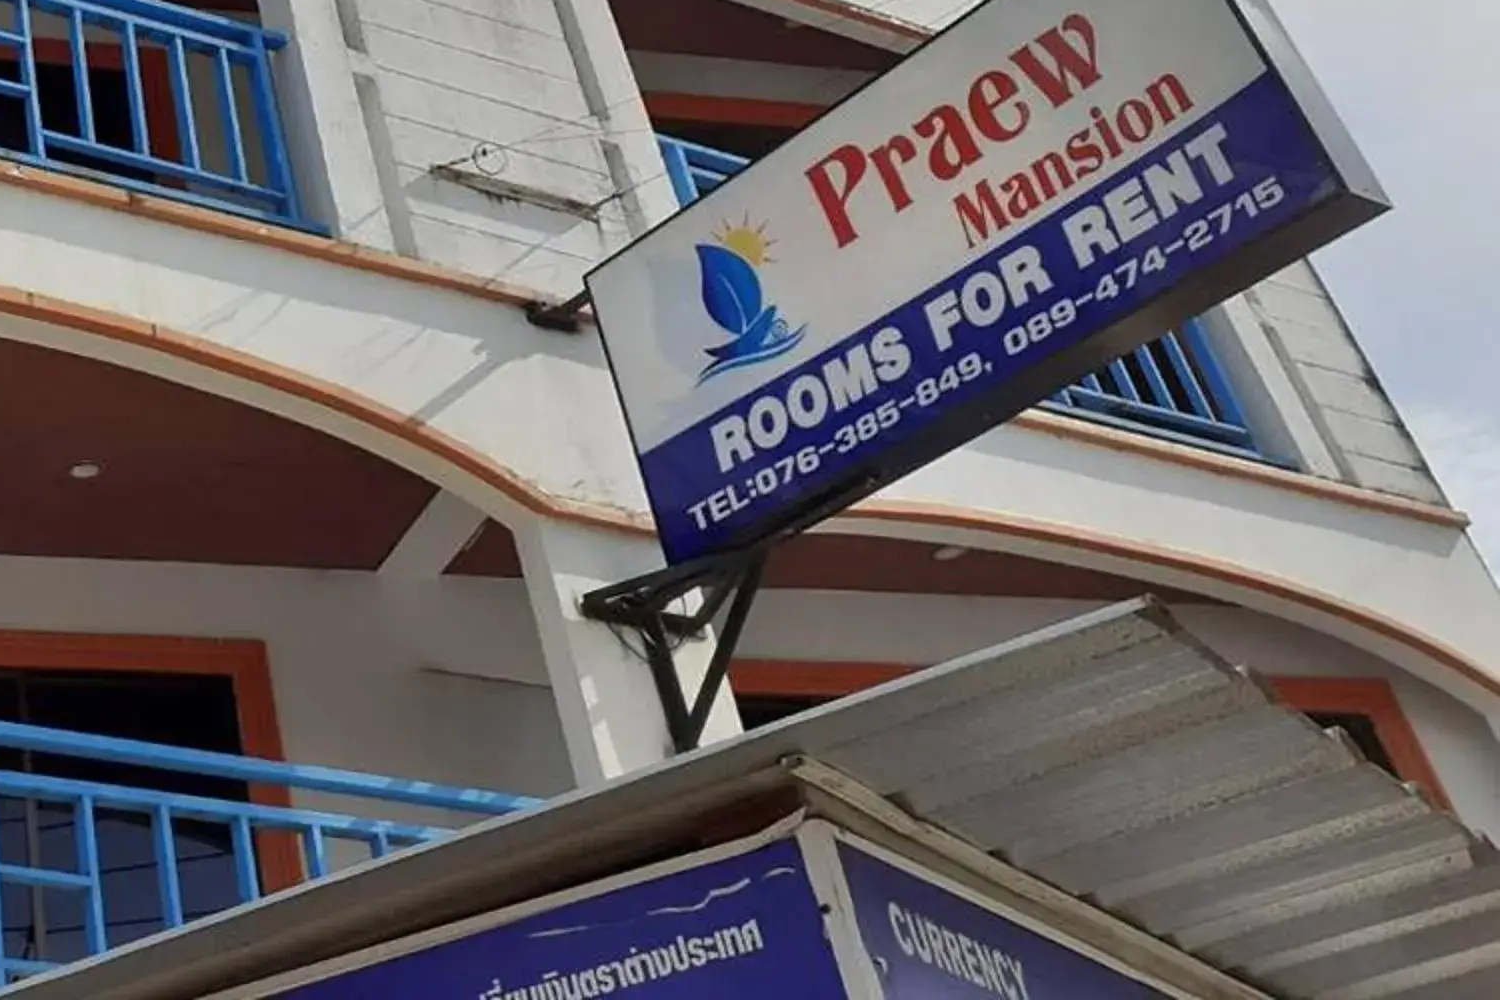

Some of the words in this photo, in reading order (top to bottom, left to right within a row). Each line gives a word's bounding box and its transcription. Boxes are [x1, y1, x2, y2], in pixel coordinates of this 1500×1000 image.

[804, 13, 1103, 249] Praew
[951, 72, 1195, 249] Mansion
[710, 326, 912, 474] ROOMS
[923, 244, 1054, 352] FOR
[1062, 122, 1235, 270] RENT
[1004, 176, 1285, 356] 089-474-2715
[888, 901, 1030, 1000] CURRENCY
